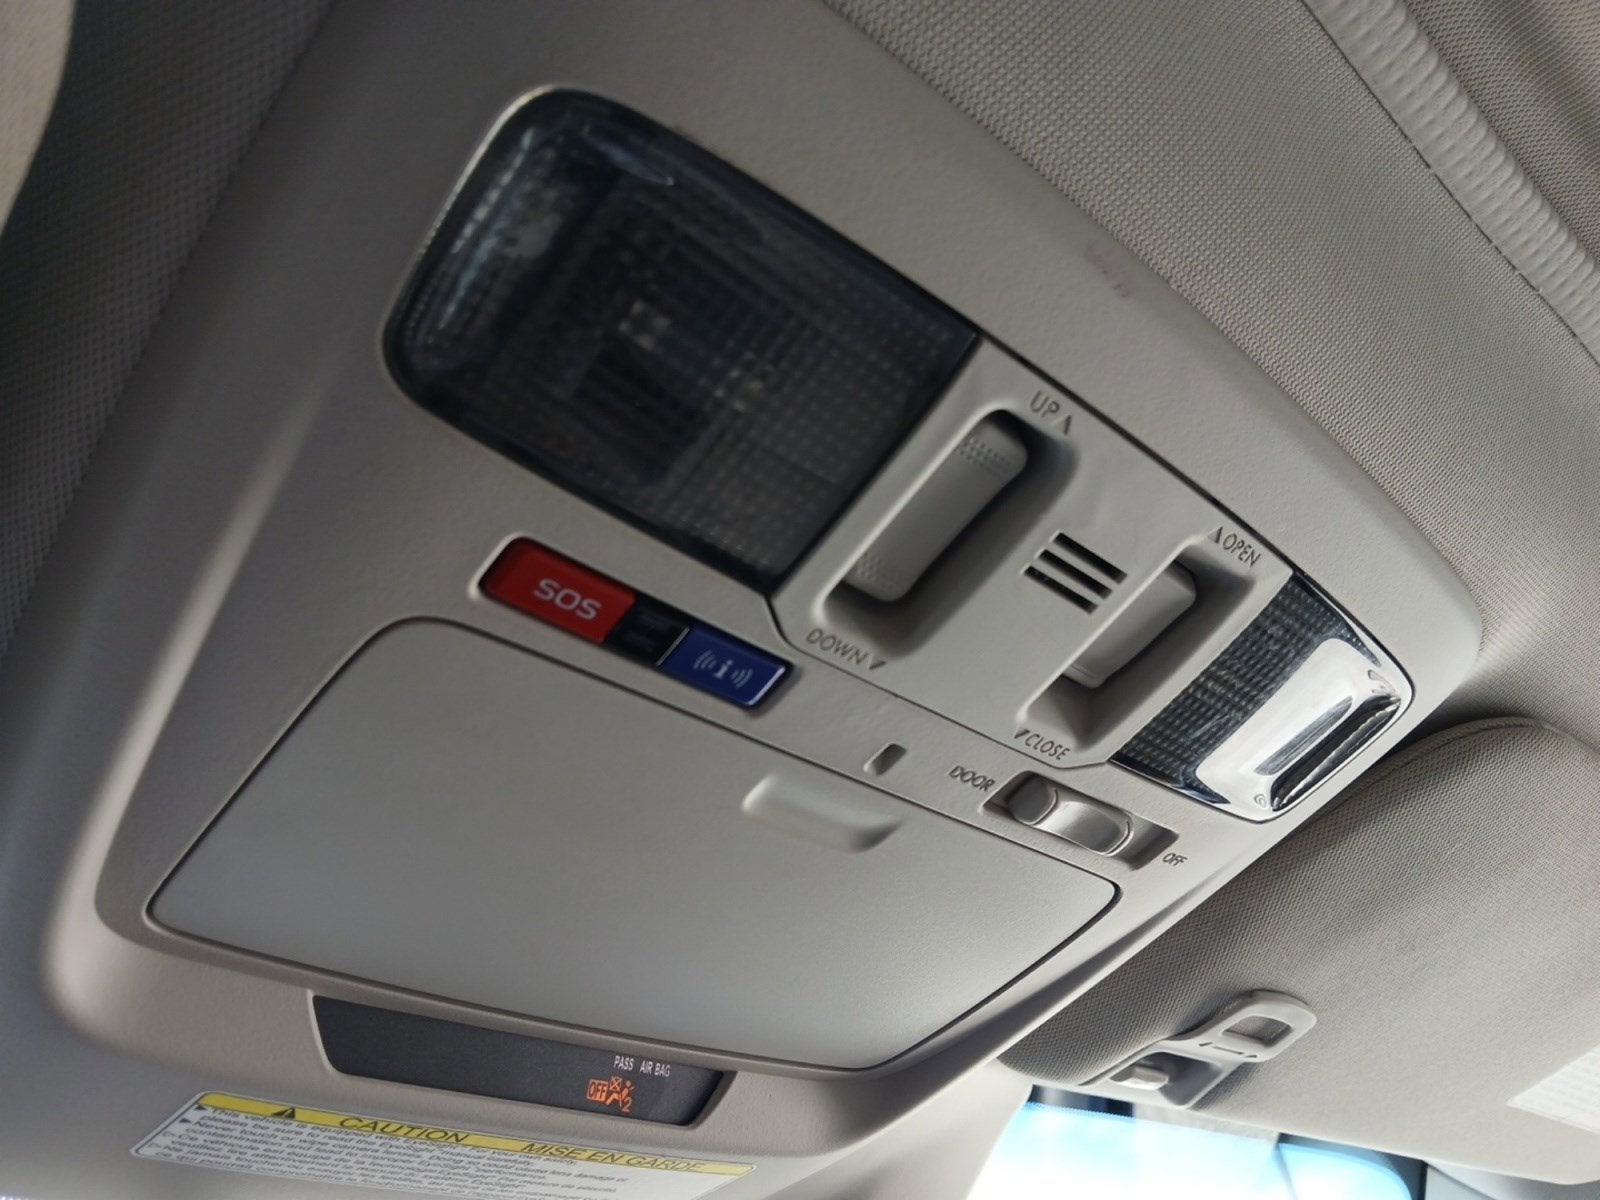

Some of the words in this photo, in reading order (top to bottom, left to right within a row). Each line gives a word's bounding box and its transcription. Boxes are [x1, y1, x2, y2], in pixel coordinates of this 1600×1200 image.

[1030, 389, 1060, 417] UP
[1222, 533, 1261, 567] OPEN
[533, 577, 602, 621] SOS
[806, 628, 870, 665] DOWN
[1024, 732, 1071, 761] CLOSE
[949, 765, 995, 792] DOOR
[1162, 852, 1188, 867] OFF
[613, 1055, 634, 1071] PASS
[640, 1060, 653, 1074] AIR
[654, 1063, 671, 1077] BAG
[588, 1081, 607, 1100] OFF
[210, 1107, 243, 1117] This
[244, 1114, 295, 1126] vehicle
[340, 1117, 470, 1143] CAUTION
[520, 1143, 586, 1158] MISE
[586, 1151, 624, 1163] EN
[623, 1156, 706, 1172] GARDE
